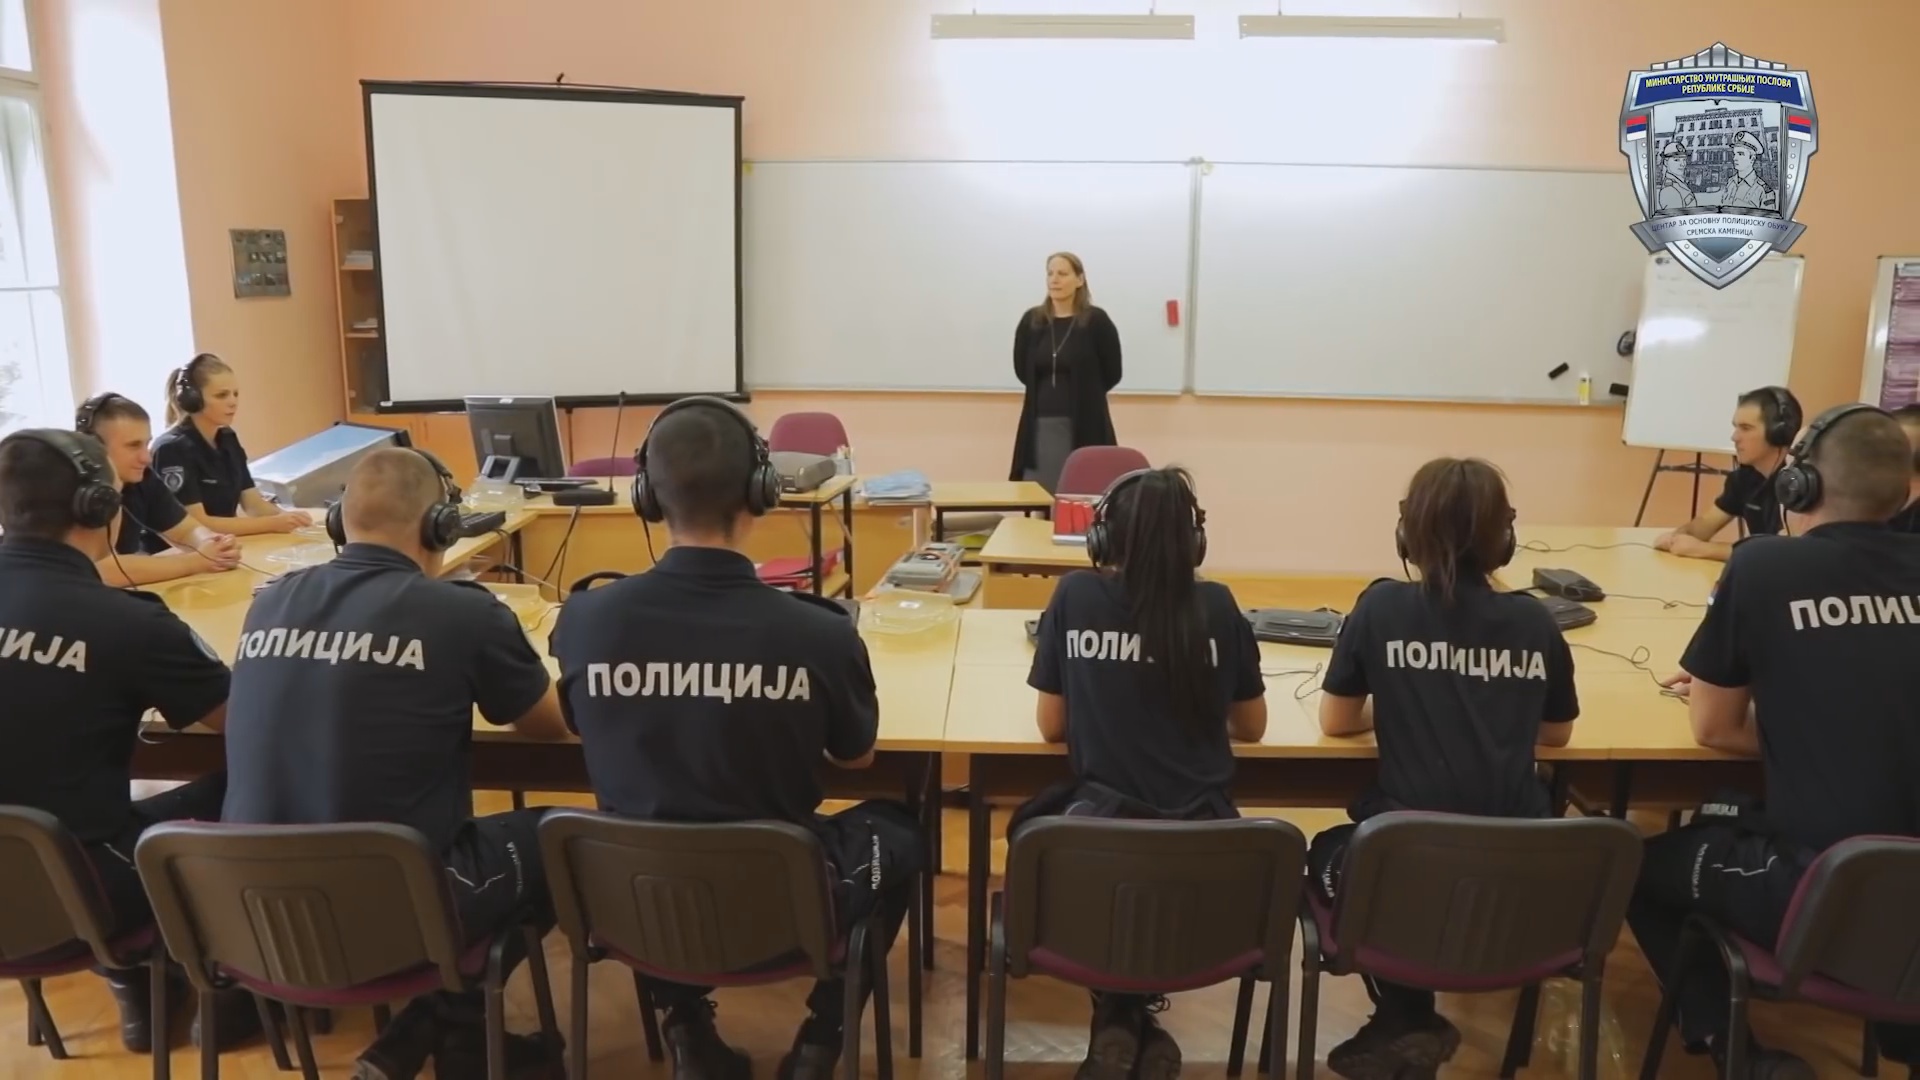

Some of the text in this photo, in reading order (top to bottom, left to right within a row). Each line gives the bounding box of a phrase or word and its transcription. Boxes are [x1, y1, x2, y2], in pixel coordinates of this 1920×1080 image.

[0, 626, 86, 673] ИЈА
[1386, 639, 1547, 682] ПОЛИЦИЈА
[587, 662, 810, 704] ПОЛИЦИЈА
